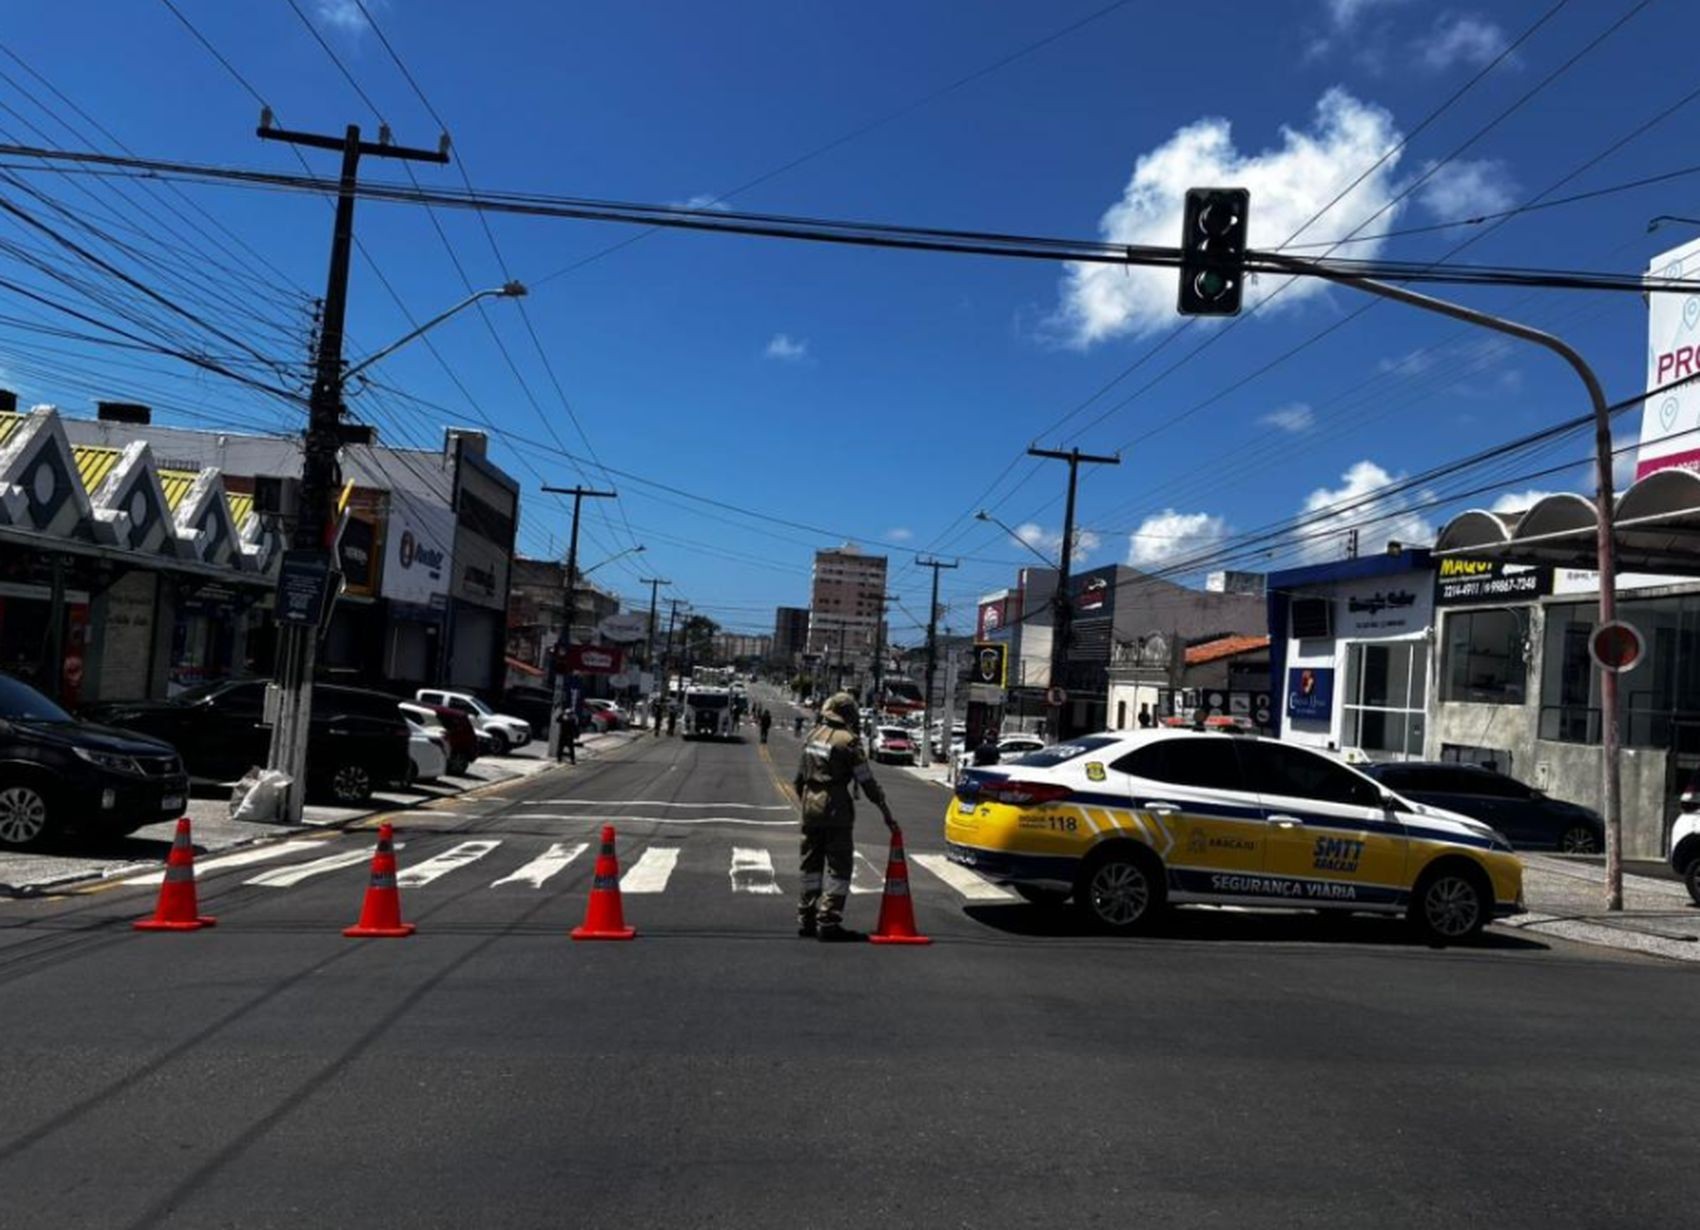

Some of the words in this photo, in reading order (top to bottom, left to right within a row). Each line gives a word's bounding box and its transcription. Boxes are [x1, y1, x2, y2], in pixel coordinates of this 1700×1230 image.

[1047, 816, 1077, 832] 118
[1314, 837, 1365, 858] SMTT
[1212, 875, 1302, 896] SEGURANÇA
